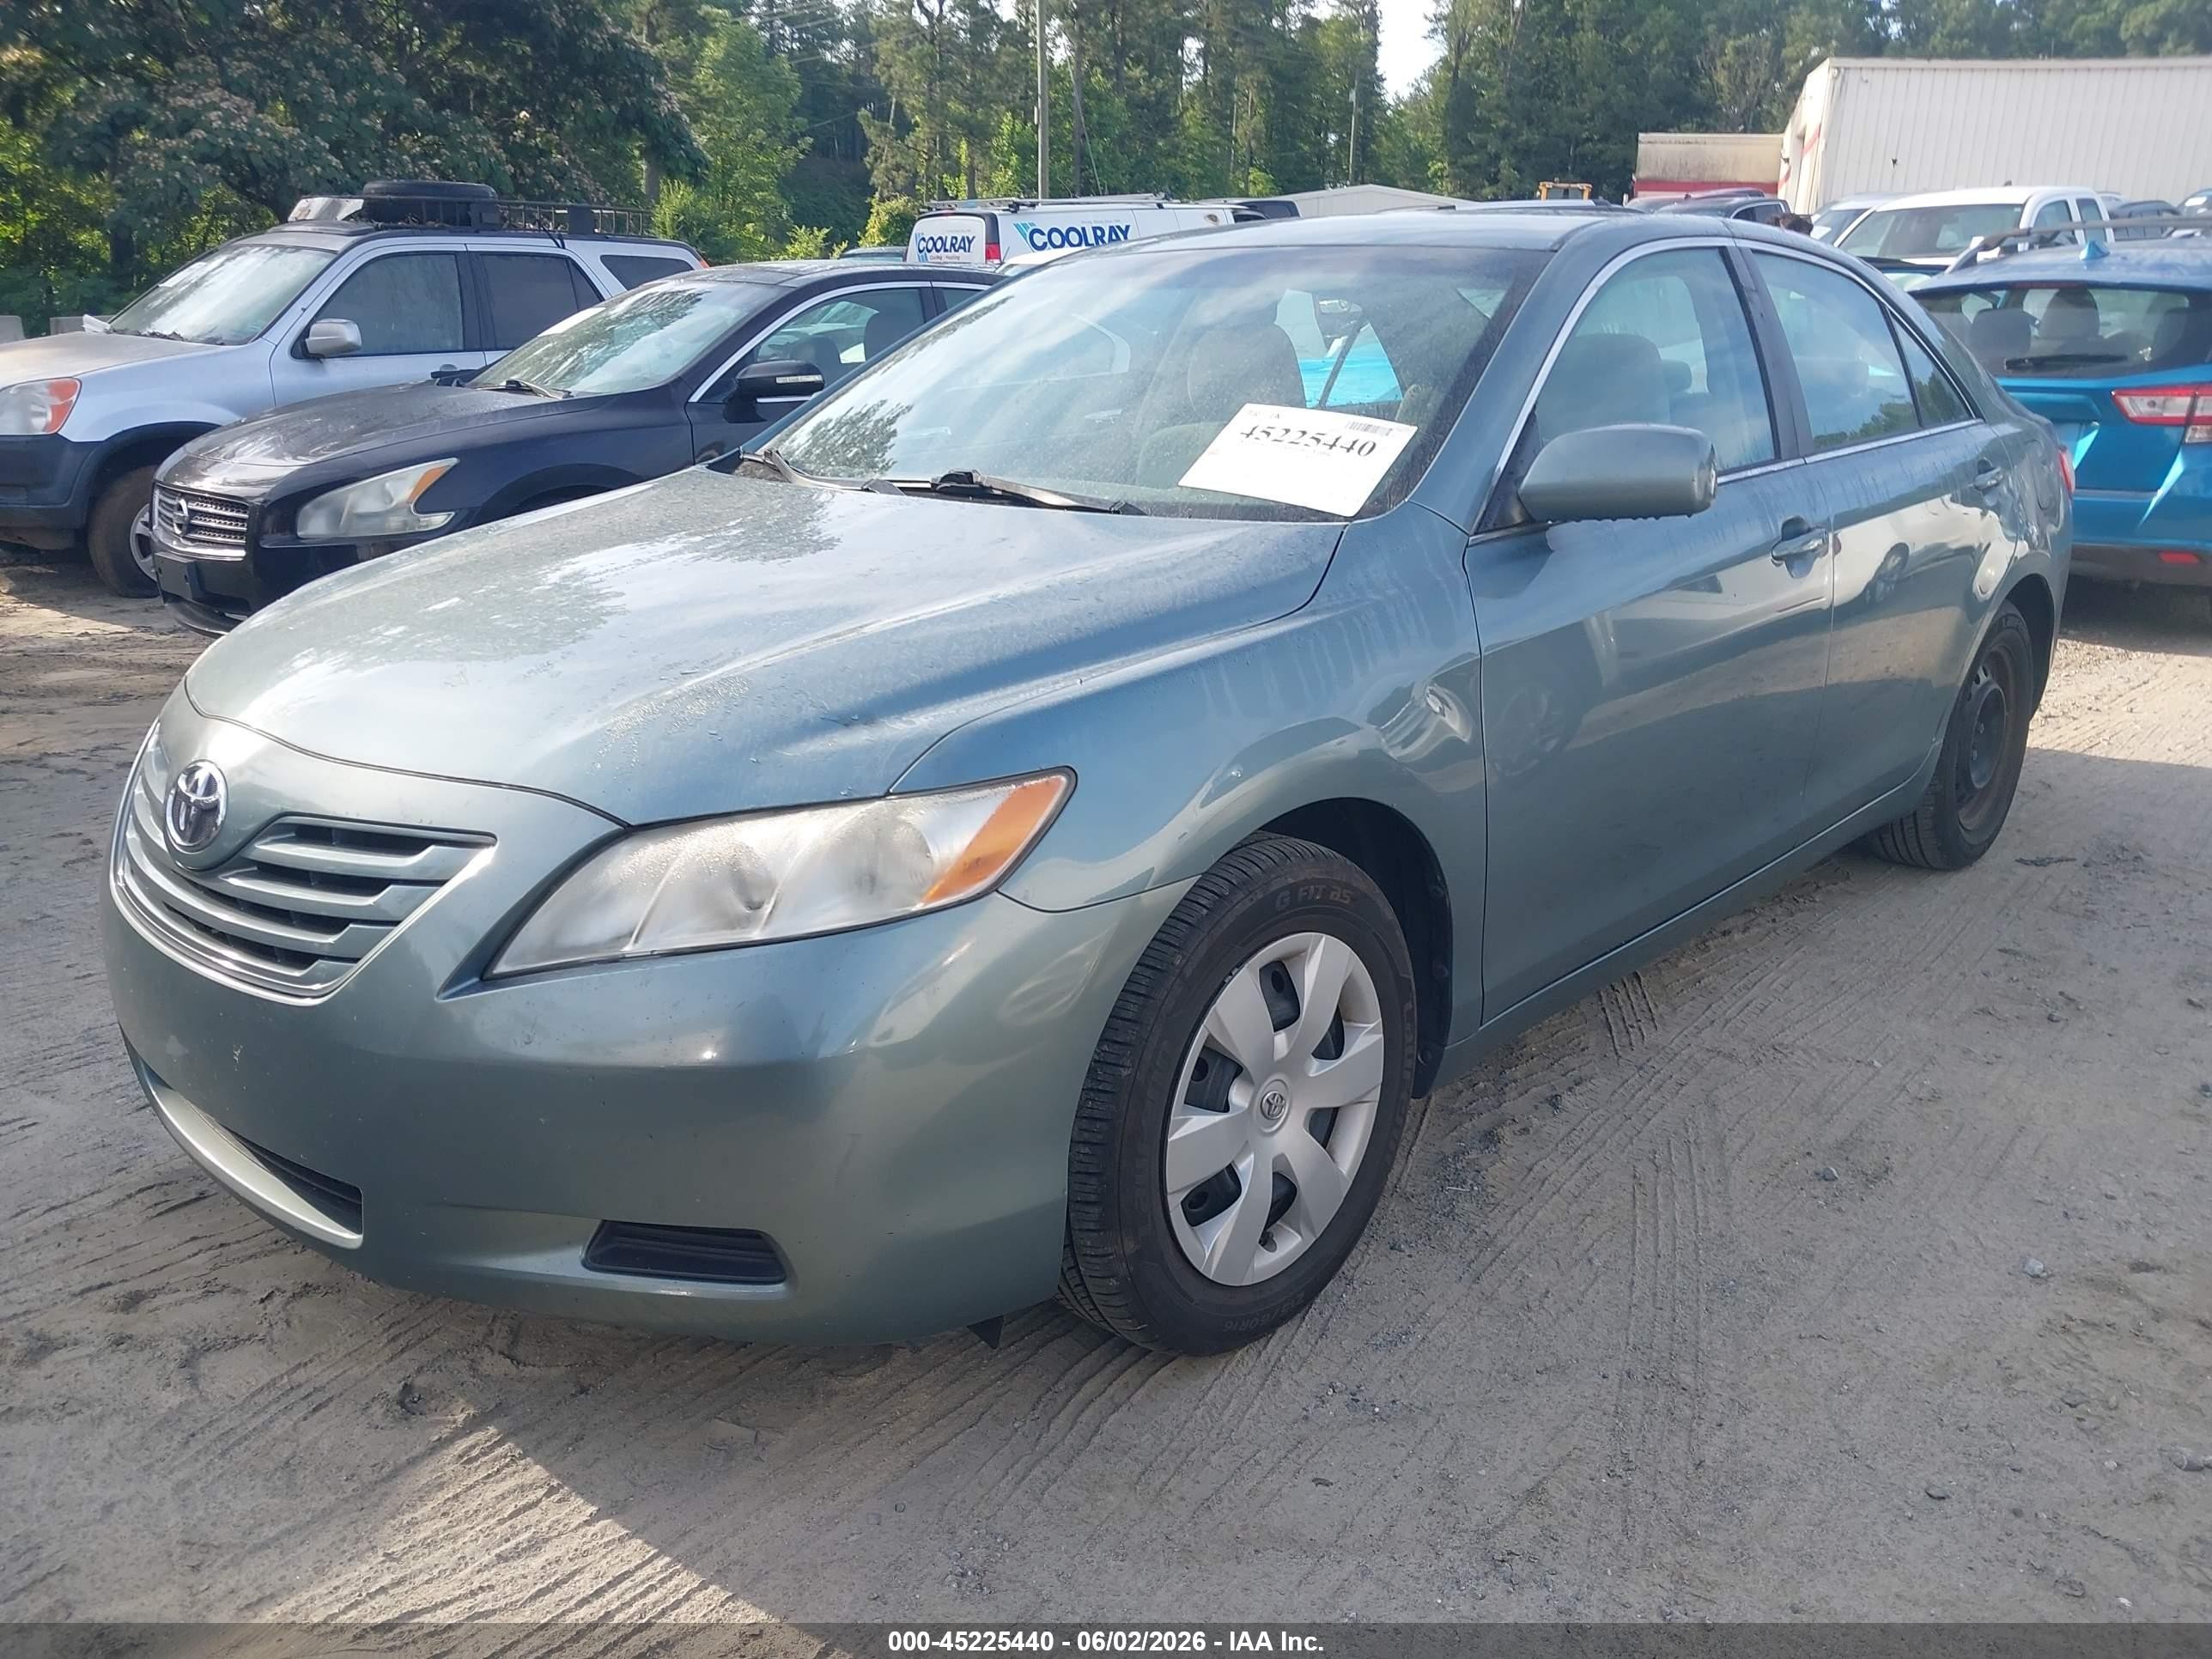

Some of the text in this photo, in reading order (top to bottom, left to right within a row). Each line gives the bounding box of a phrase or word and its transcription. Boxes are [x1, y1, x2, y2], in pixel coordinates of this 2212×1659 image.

[917, 235, 975, 253] COOLRAY
[1029, 224, 1131, 252] COOLRAY
[1238, 424, 1377, 457] 45225440
[1276, 890, 1291, 911] G
[1297, 884, 1327, 902] FIT
